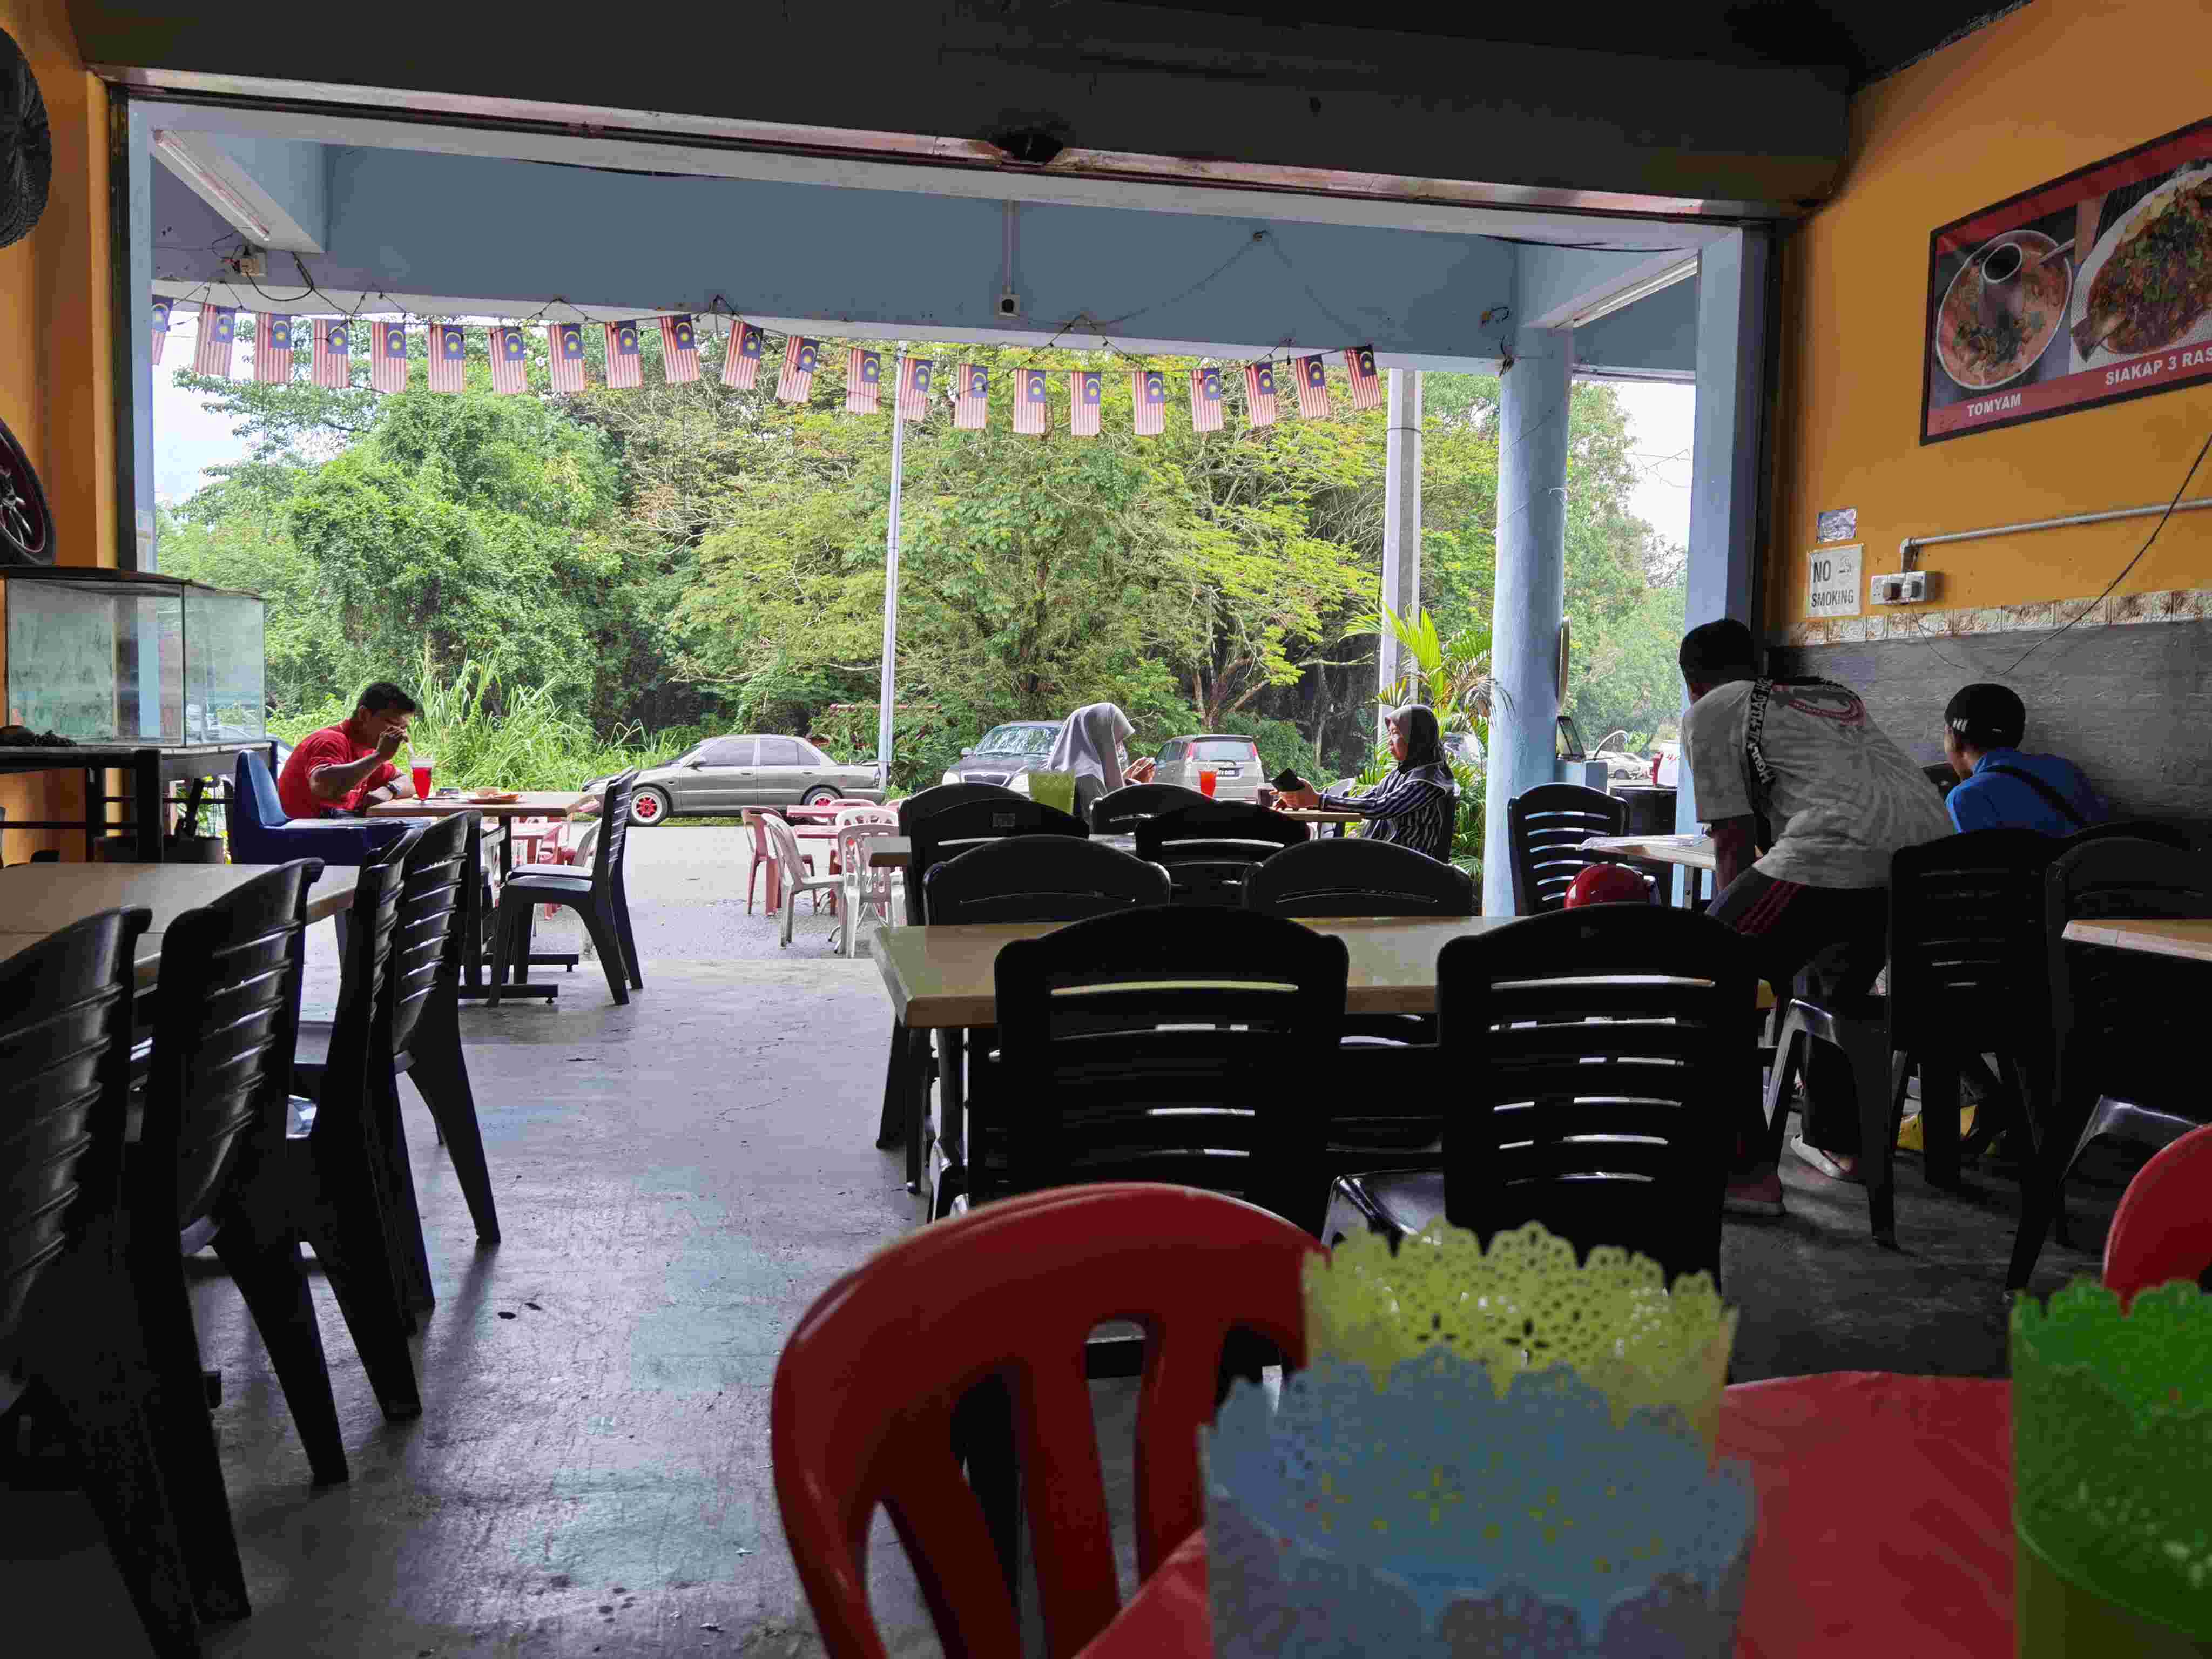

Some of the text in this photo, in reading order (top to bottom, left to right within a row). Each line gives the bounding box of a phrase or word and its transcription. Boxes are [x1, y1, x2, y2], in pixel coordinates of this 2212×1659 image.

[2105, 347, 2212, 385] SIAKAP 3 RAS
[1966, 393, 2021, 417] TOMYAM
[1813, 560, 1831, 583] NO
[1811, 589, 1854, 608] SMOKING
